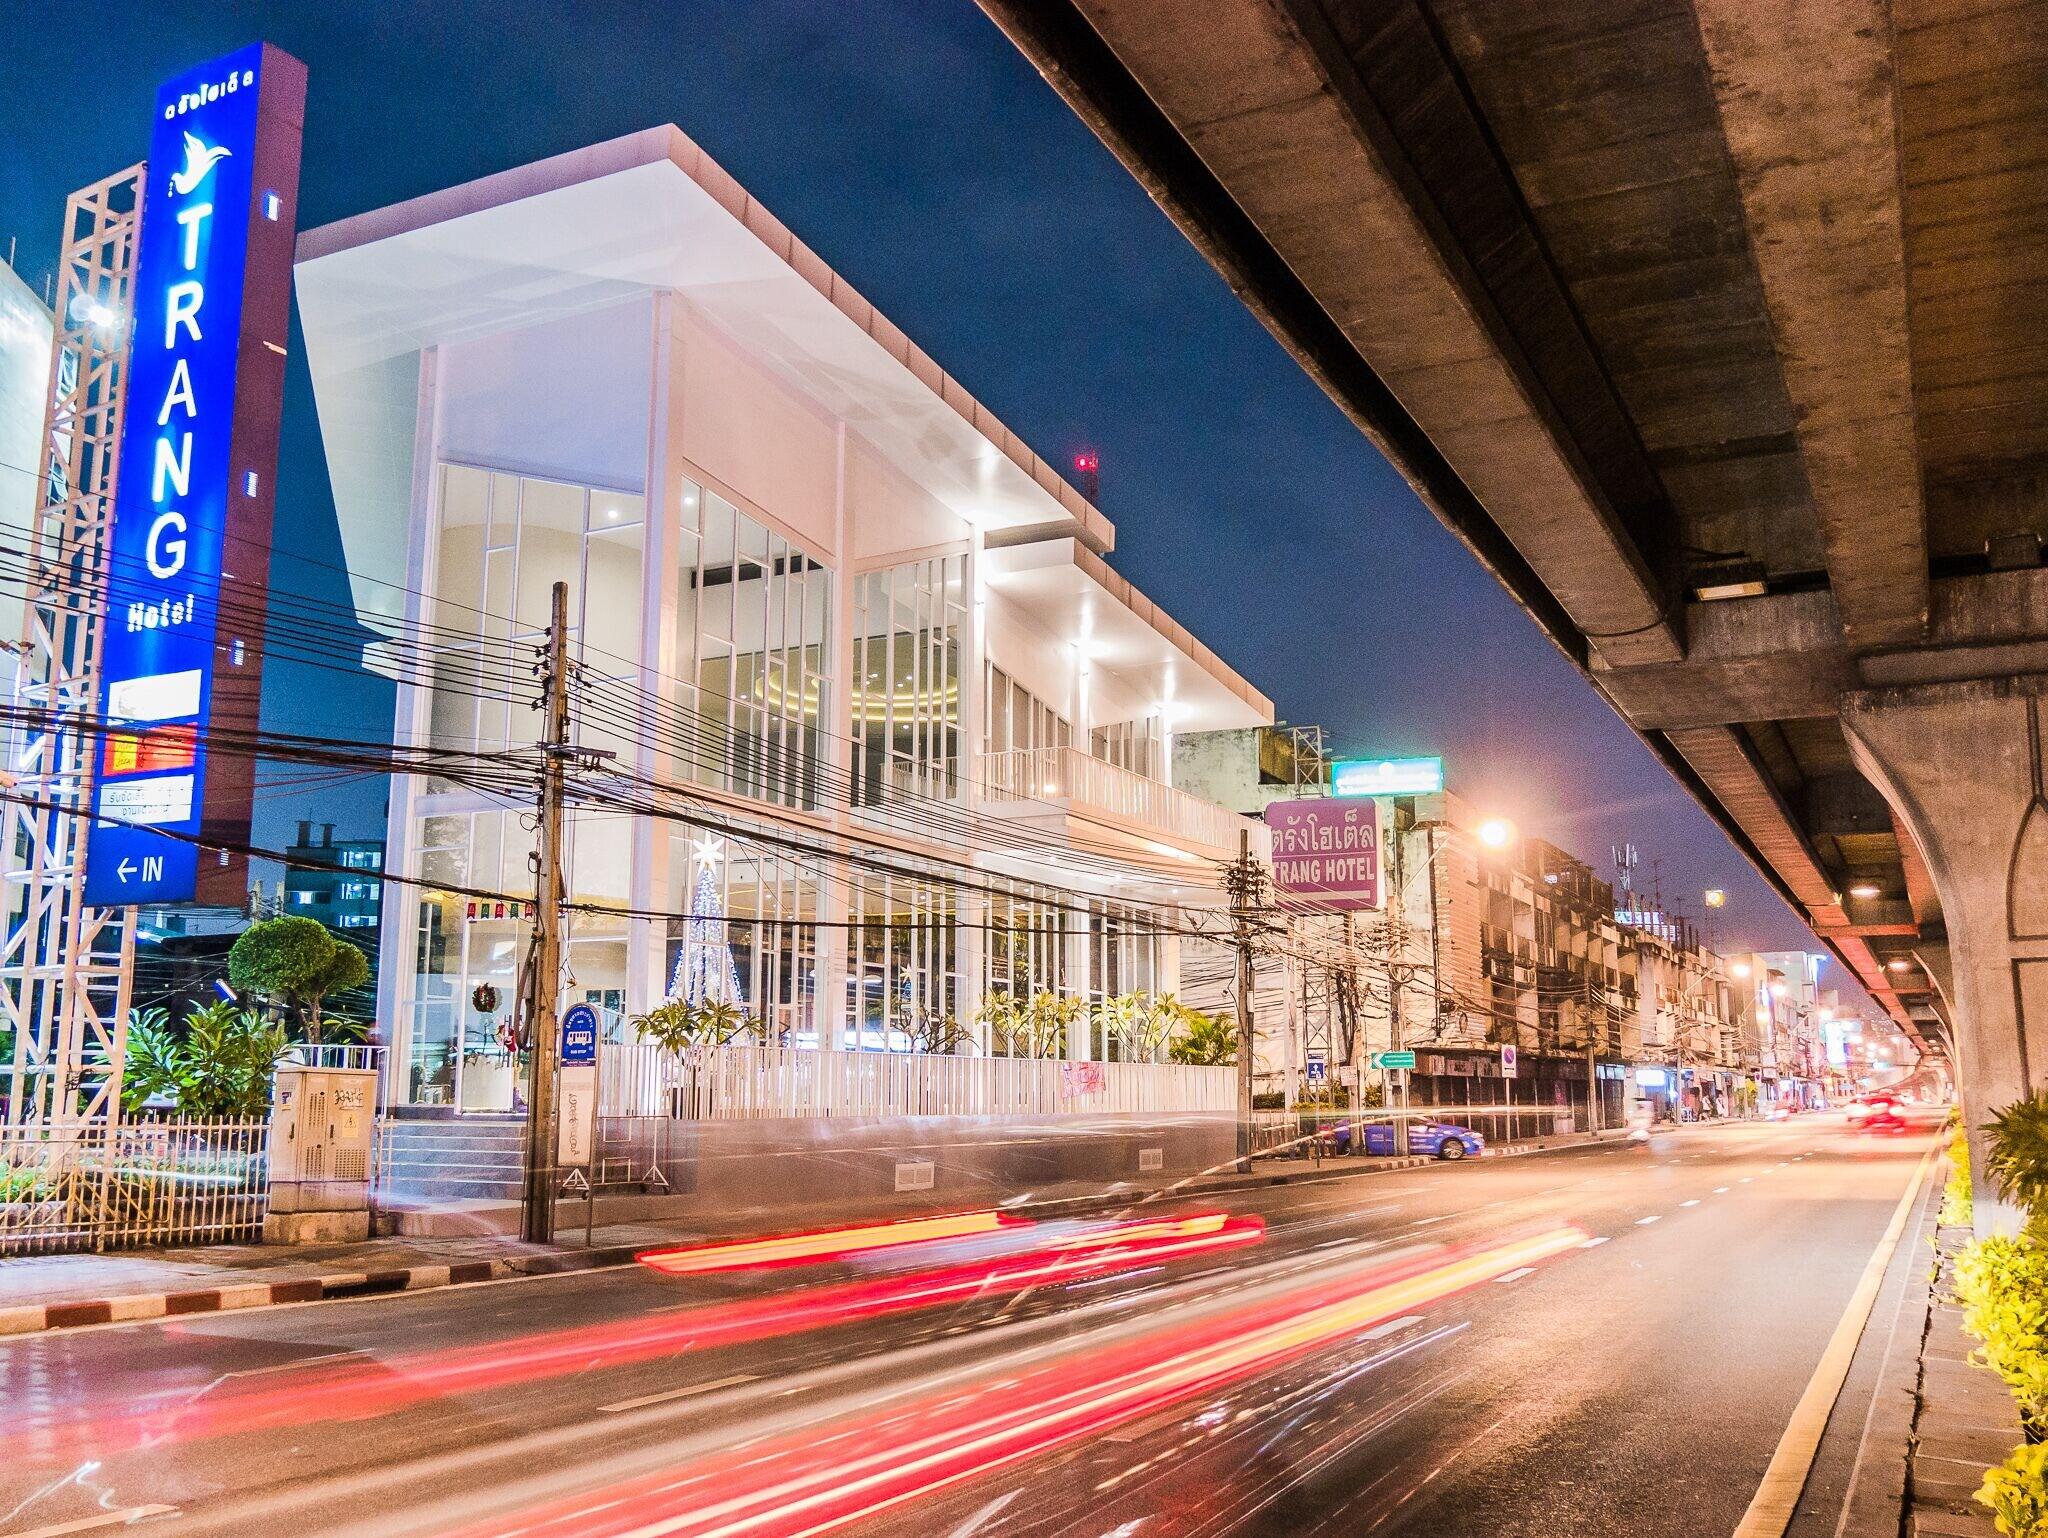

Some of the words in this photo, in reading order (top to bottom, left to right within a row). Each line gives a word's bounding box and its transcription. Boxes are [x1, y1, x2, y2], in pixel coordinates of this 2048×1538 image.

[146, 203, 213, 579] TRANG
[127, 593, 195, 633] Hotel
[1271, 808, 1375, 853] ตรังโฮเต็ล
[142, 856, 163, 882] IN
[1272, 859, 1321, 884] TRANG
[1326, 857, 1375, 882] HOTEL
